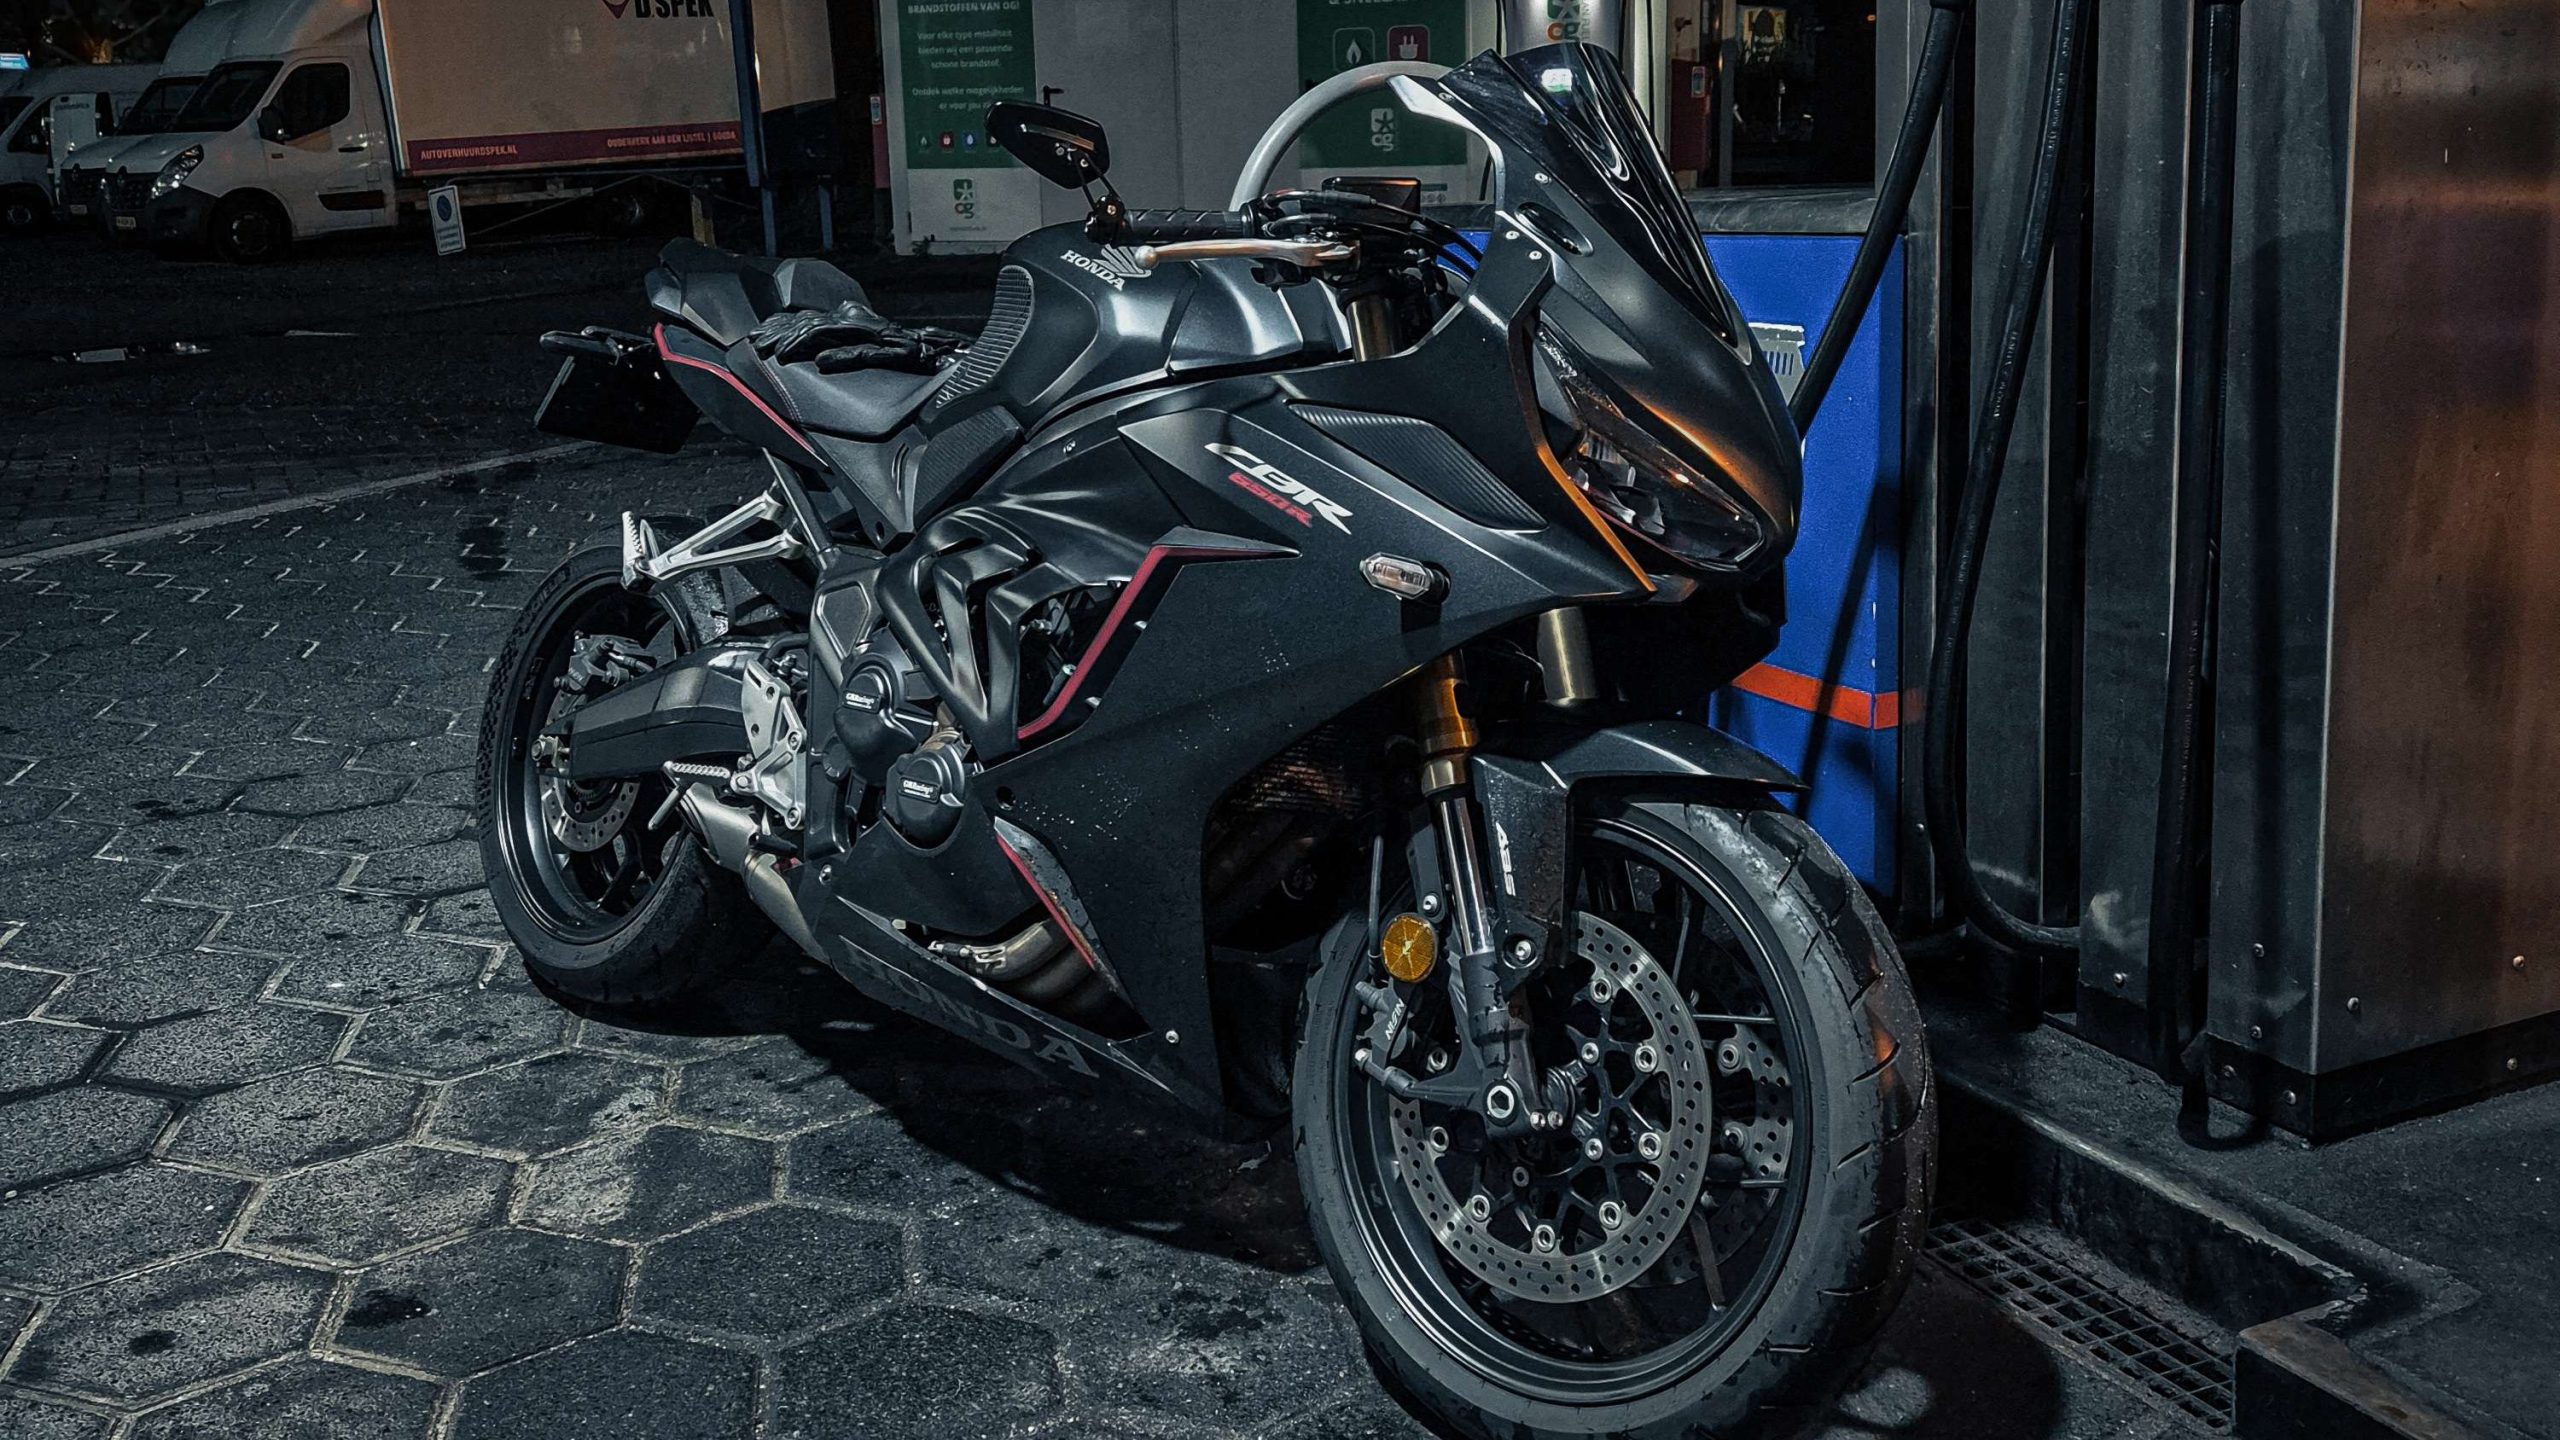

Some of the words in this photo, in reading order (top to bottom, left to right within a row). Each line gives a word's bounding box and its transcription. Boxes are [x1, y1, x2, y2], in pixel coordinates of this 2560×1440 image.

[907, 3, 978, 14] BRANDSTOFFEN
[980, 1, 1000, 11] VAN
[917, 32, 935, 41] Voor
[937, 31, 953, 40] elke
[955, 31, 972, 41] type
[918, 46, 945, 55] bieden
[959, 46, 974, 54] een
[931, 60, 958, 69] schone
[912, 87, 939, 96] Ontdek
[941, 86, 964, 96] welke
[949, 102, 967, 110] voor
[1060, 249, 1125, 292] HONDA
[1204, 442, 1354, 536] CBR
[1495, 821, 1517, 897] ABS
[842, 940, 1100, 1078] HONDA
